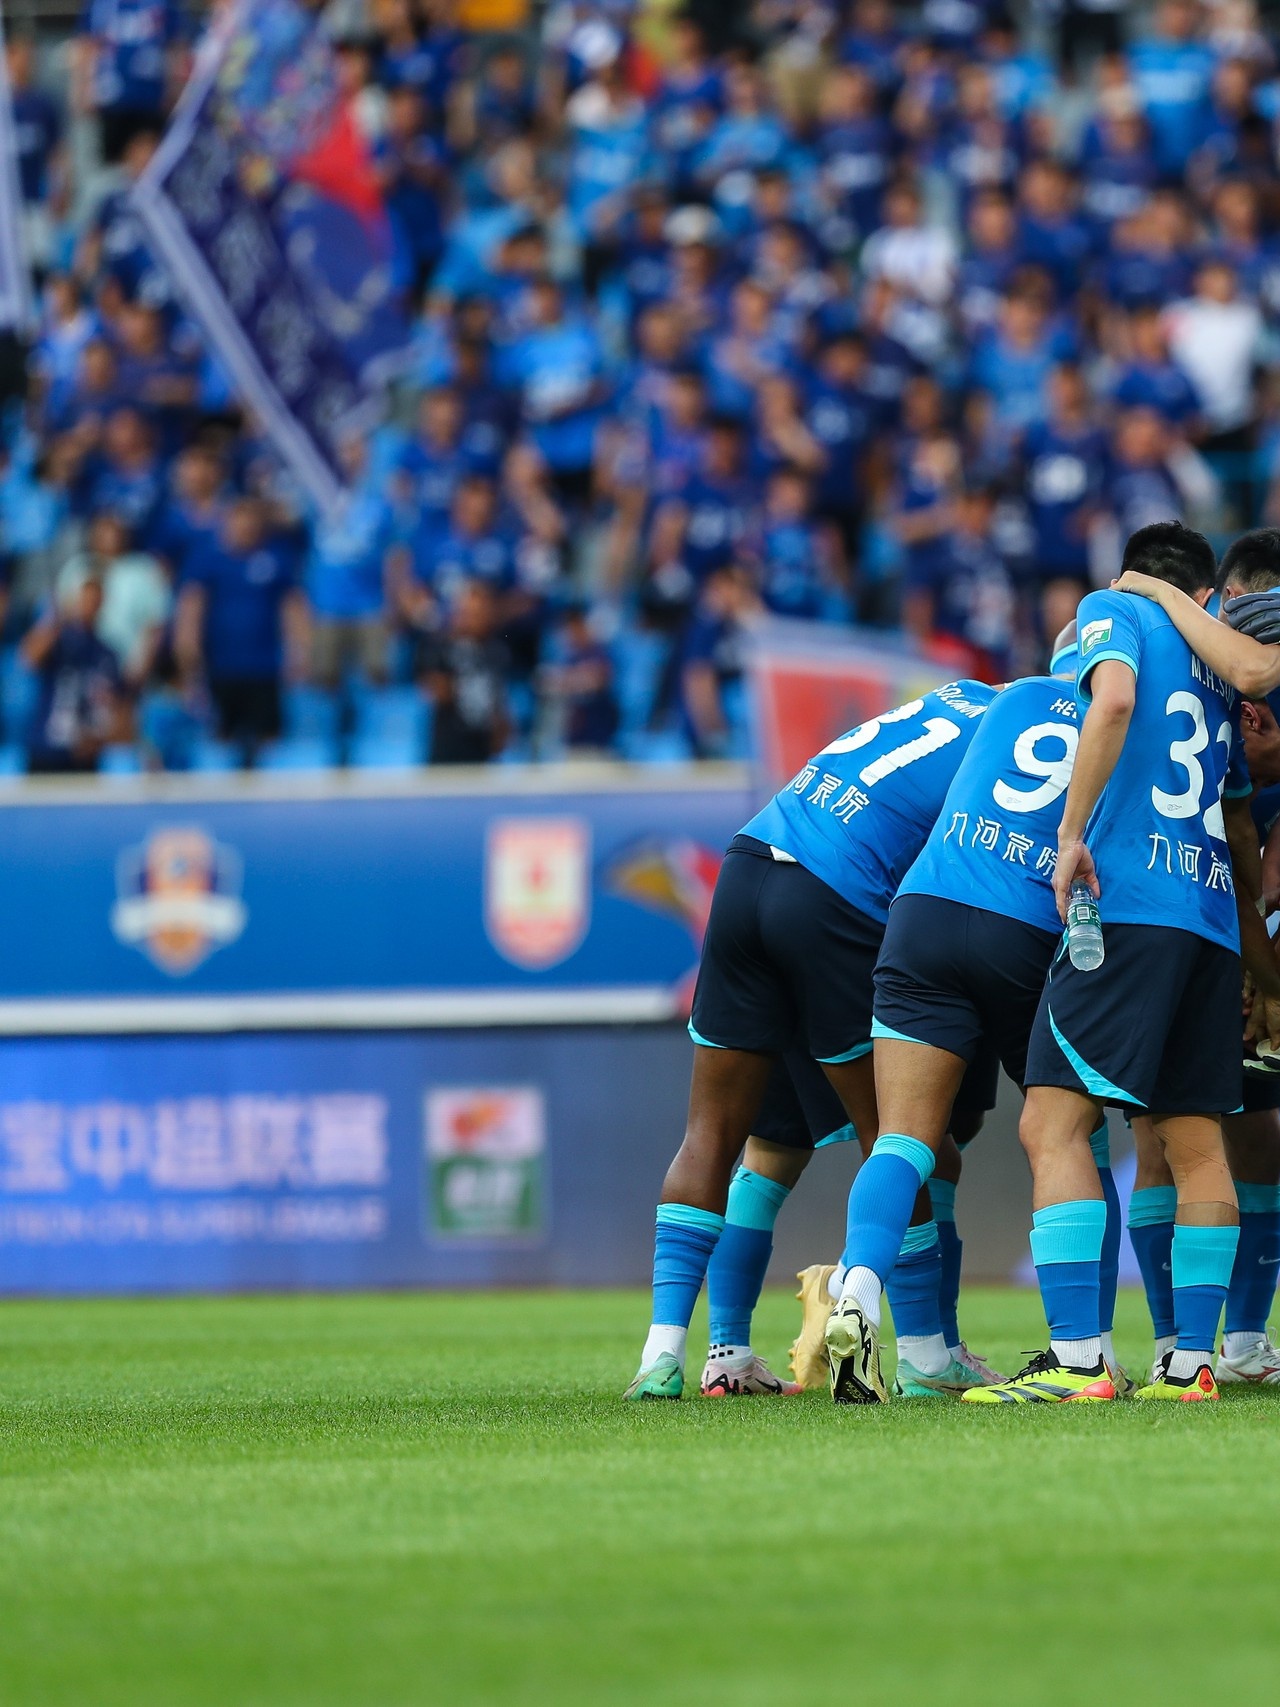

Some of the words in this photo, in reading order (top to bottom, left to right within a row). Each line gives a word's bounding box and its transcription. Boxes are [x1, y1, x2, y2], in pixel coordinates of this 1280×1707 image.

[1049, 698, 1077, 719] HE
[785, 764, 871, 824] 河宸院
[992, 721, 1080, 813] 9
